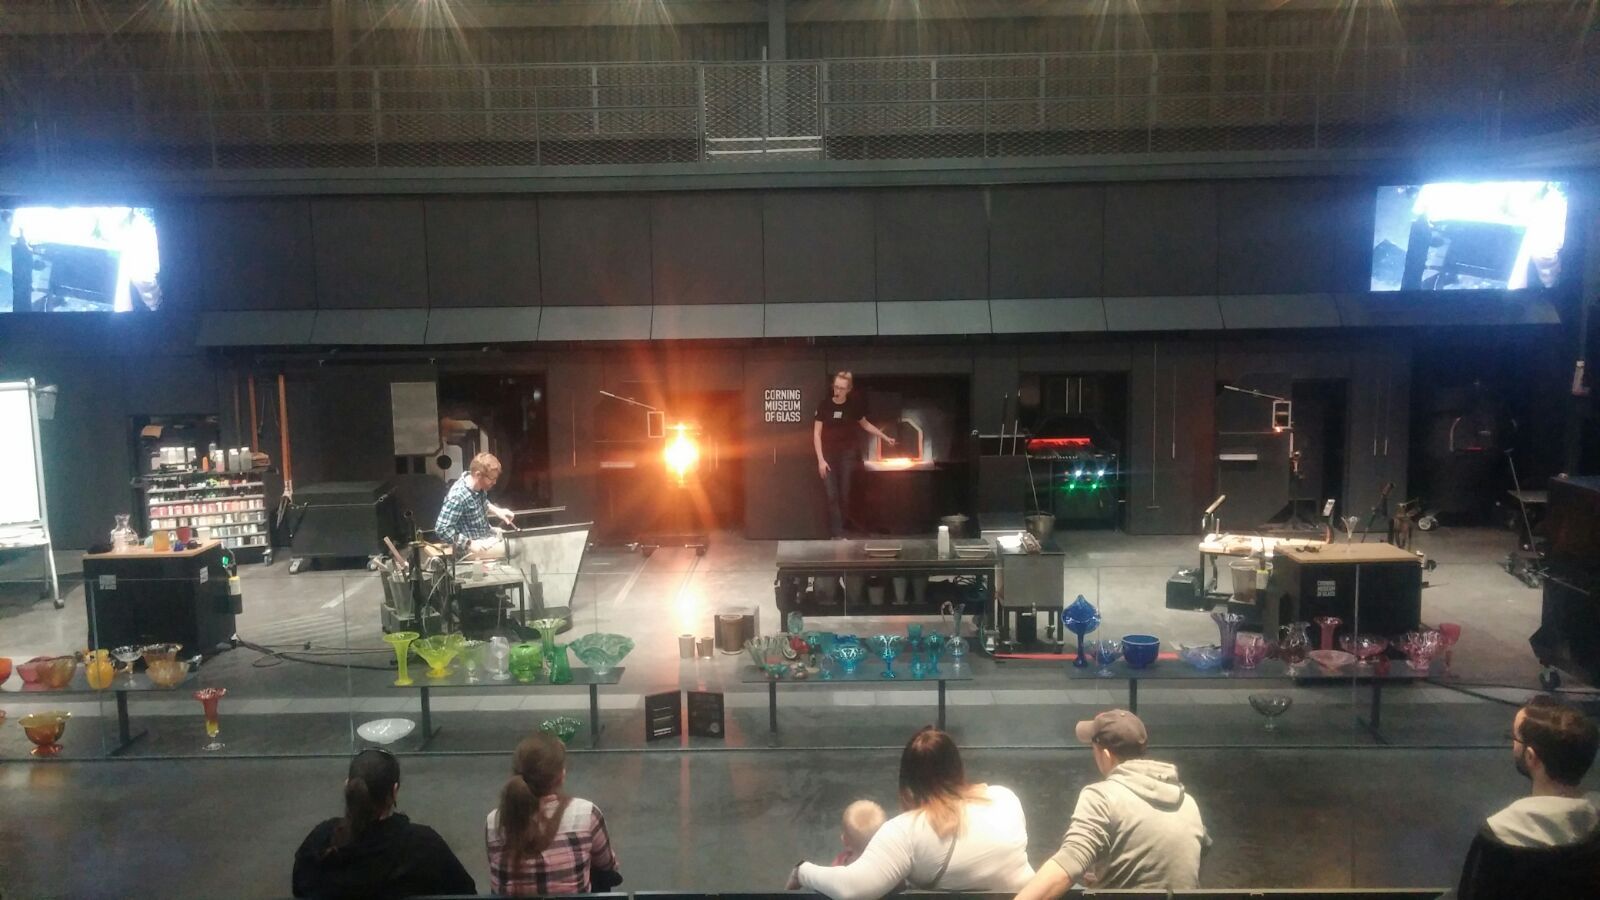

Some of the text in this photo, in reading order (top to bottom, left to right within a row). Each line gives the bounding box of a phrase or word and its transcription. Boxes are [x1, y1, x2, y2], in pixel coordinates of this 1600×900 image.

[765, 389, 800, 400] CORNING
[765, 400, 800, 411] MUSEUM
[765, 411, 800, 422] OF GLASS
